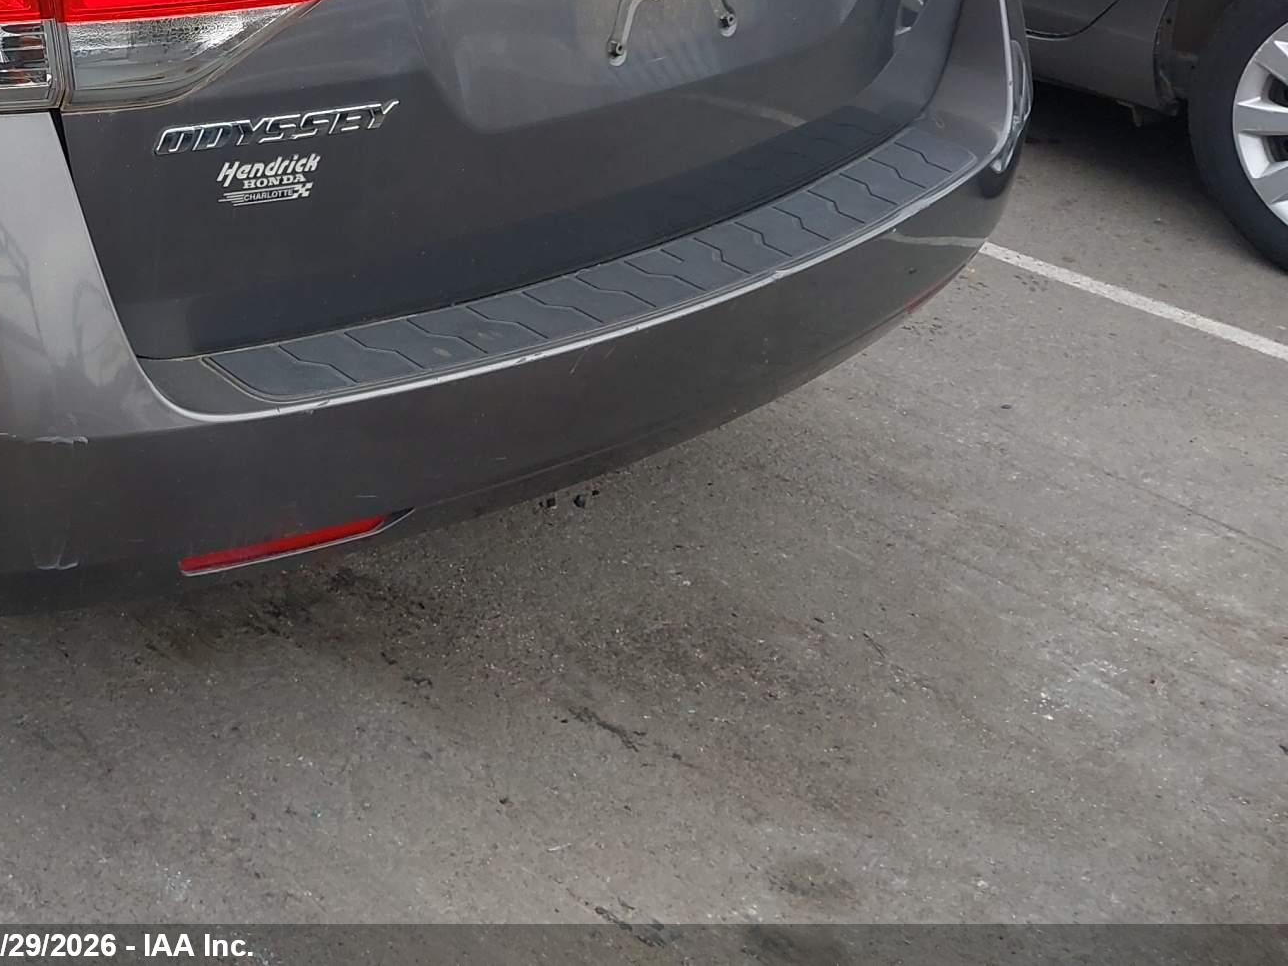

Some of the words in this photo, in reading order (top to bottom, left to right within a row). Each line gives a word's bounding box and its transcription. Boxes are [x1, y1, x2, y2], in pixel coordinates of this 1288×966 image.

[153, 99, 399, 154] ODYSSEY
[216, 153, 321, 187] Hendrick
[242, 174, 306, 189] HONDA
[243, 189, 294, 202] CHARLOTTE
